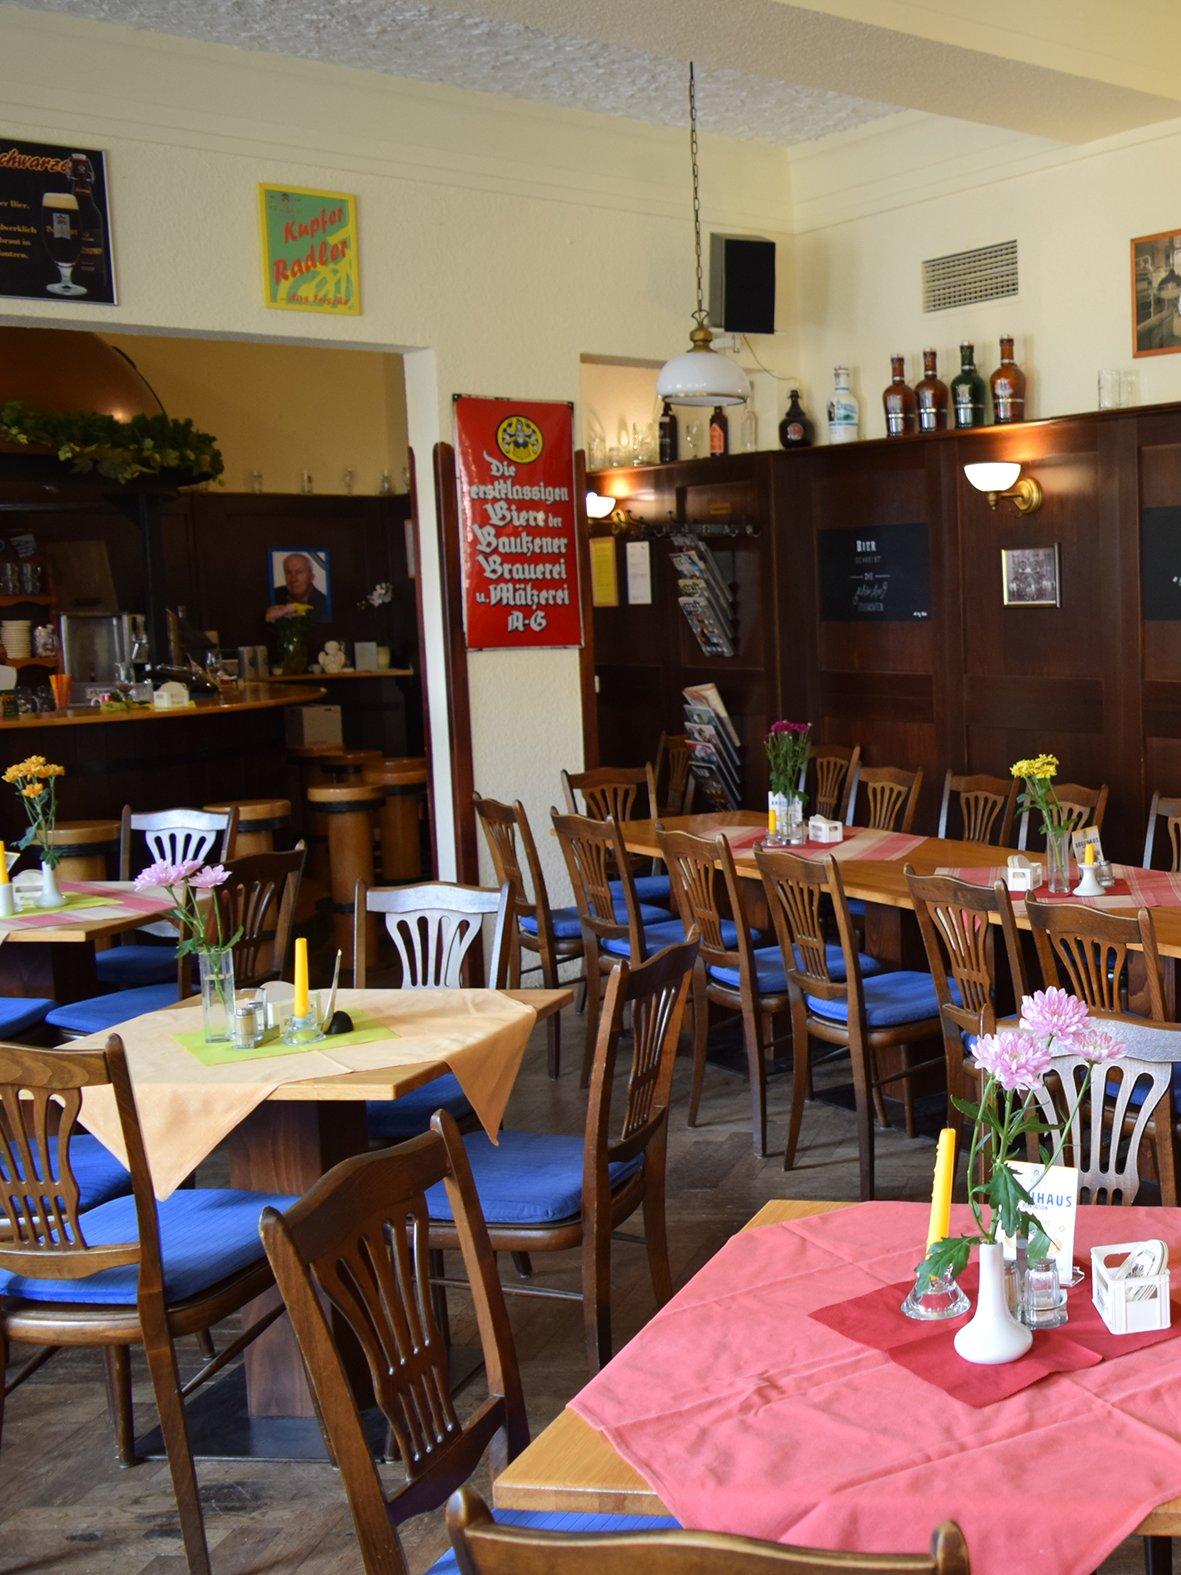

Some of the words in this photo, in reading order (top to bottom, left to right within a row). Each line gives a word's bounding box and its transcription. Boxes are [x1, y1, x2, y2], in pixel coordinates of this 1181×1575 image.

[283, 207, 344, 244] Kupfer
[273, 239, 348, 285] Radler
[483, 450, 517, 477] Die
[483, 500, 546, 527] Biere
[548, 512, 562, 528] der
[472, 524, 568, 556] Bautzener
[856, 540, 877, 552] BIER
[476, 554, 567, 580] Brauerei
[508, 611, 547, 633] A-G
